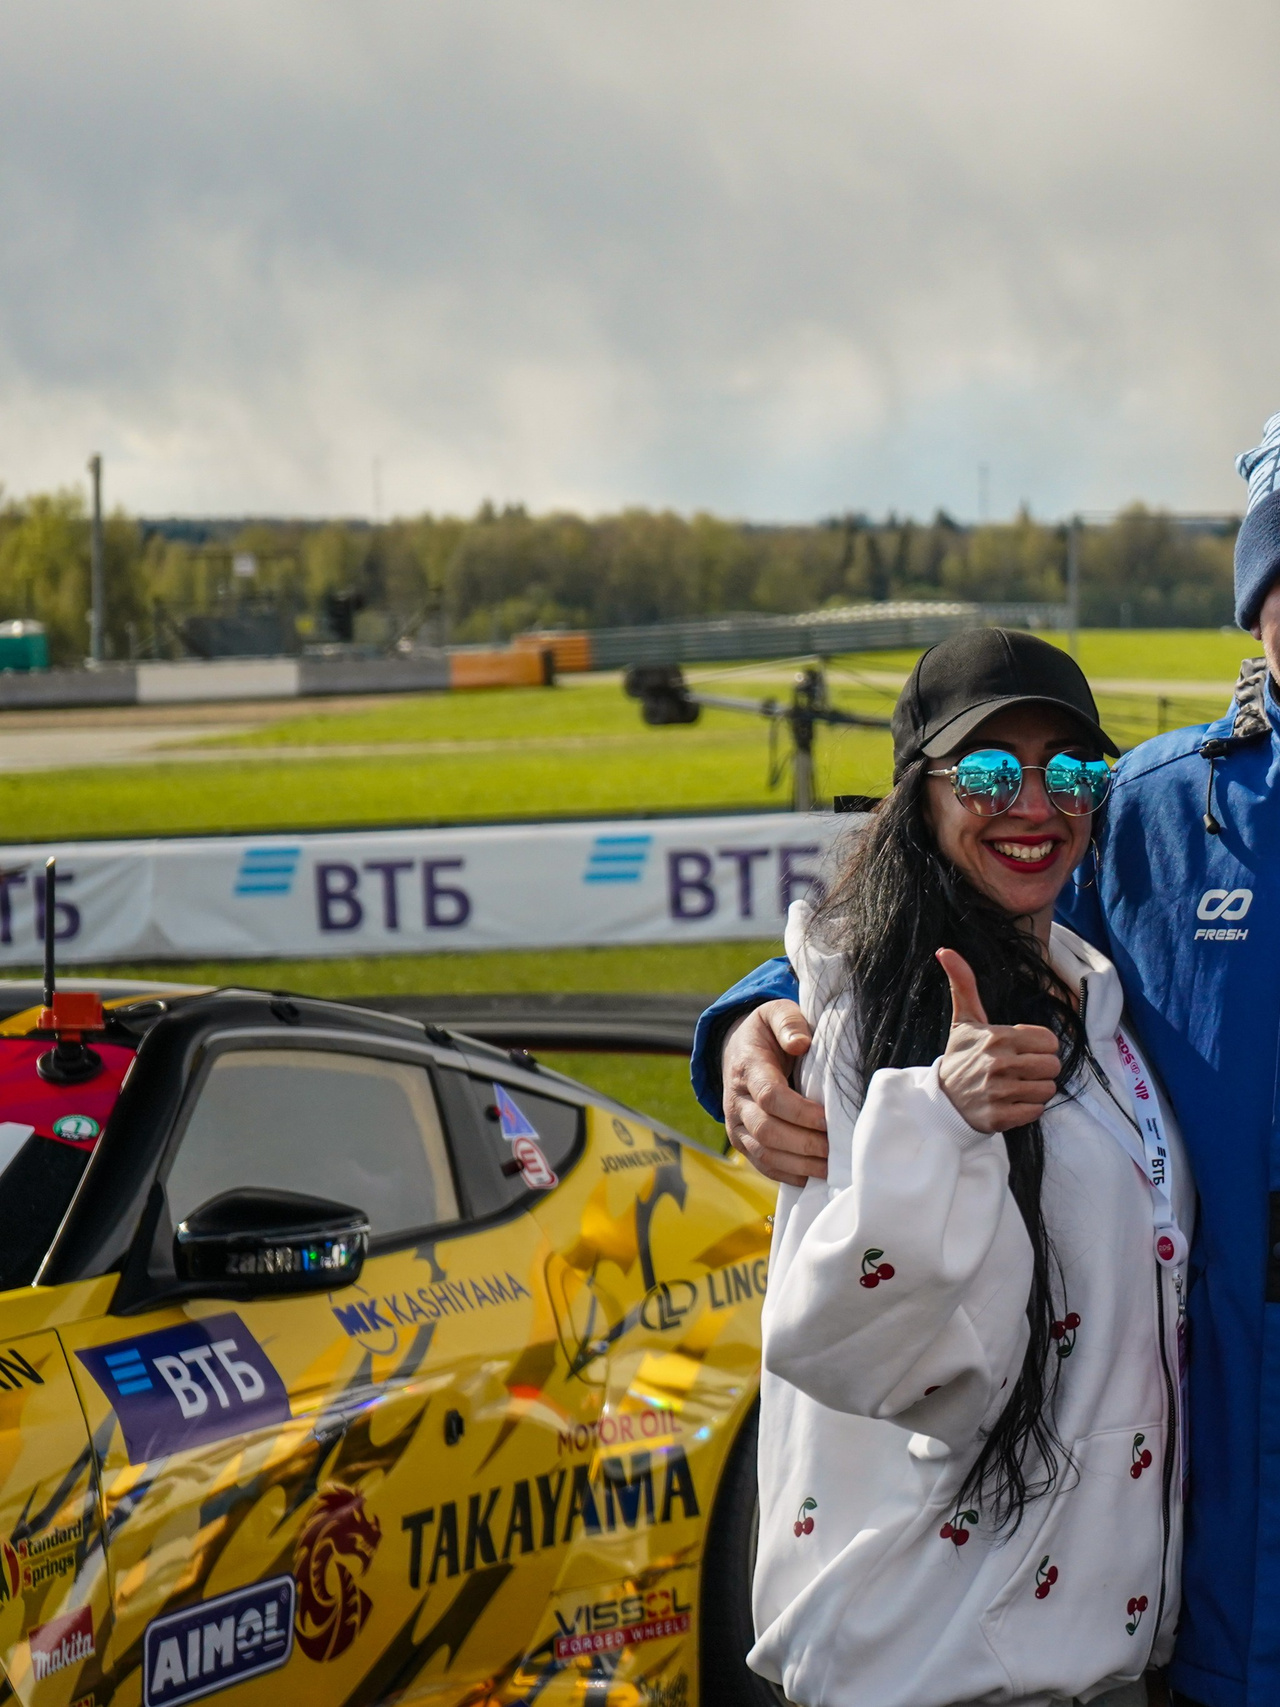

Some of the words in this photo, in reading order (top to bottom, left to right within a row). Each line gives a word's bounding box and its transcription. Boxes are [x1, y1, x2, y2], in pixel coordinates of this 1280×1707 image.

[315, 856, 473, 932] ВТБ
[667, 845, 829, 920] ВТБ
[1133, 1079, 1150, 1101] VIP
[601, 1147, 681, 1175] JONNESWA
[1151, 1158, 1165, 1186] ВТБ
[331, 1298, 395, 1337] MK
[384, 1271, 531, 1326] KASHIYAMA
[152, 1338, 265, 1419] ВТБ
[557, 1416, 634, 1455] MOTOR
[640, 1408, 683, 1439] OIL
[18, 1518, 83, 1559] Standard
[402, 1444, 701, 1590] TAKAYAMA
[22, 1552, 76, 1587] Springs
[150, 1600, 286, 1695] AIMOL
[559, 1631, 625, 1655] FORGED
